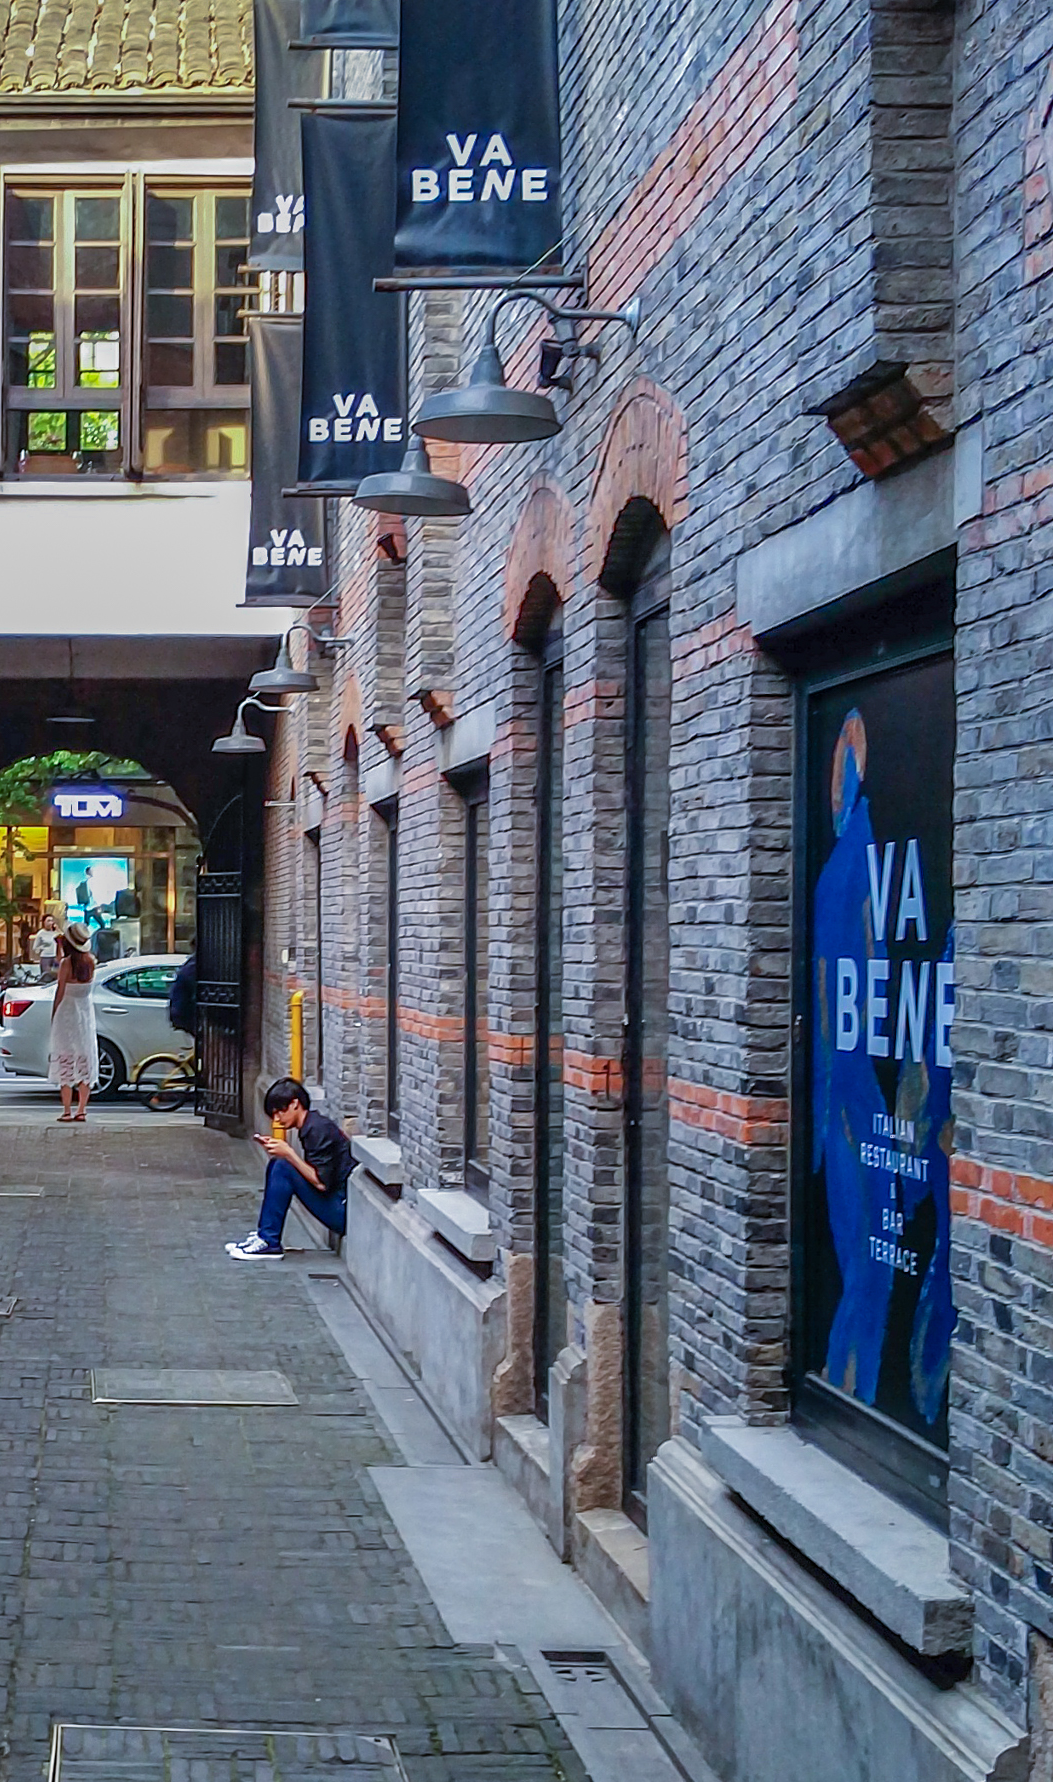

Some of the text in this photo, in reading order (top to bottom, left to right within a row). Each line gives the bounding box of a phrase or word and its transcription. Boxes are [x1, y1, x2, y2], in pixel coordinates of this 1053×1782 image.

[446, 133, 513, 167] VA
[412, 169, 548, 202] BENE
[332, 393, 379, 418] VA
[309, 417, 403, 442] BENE
[270, 528, 305, 548] VA
[252, 547, 323, 566] BENE
[866, 838, 929, 941] VA
[836, 957, 955, 1069] BENE
[873, 1112, 915, 1143] ITALIAN
[860, 1142, 929, 1183] RESTAURANT
[882, 1207, 904, 1236] BAR
[869, 1235, 918, 1276] TERRACE
